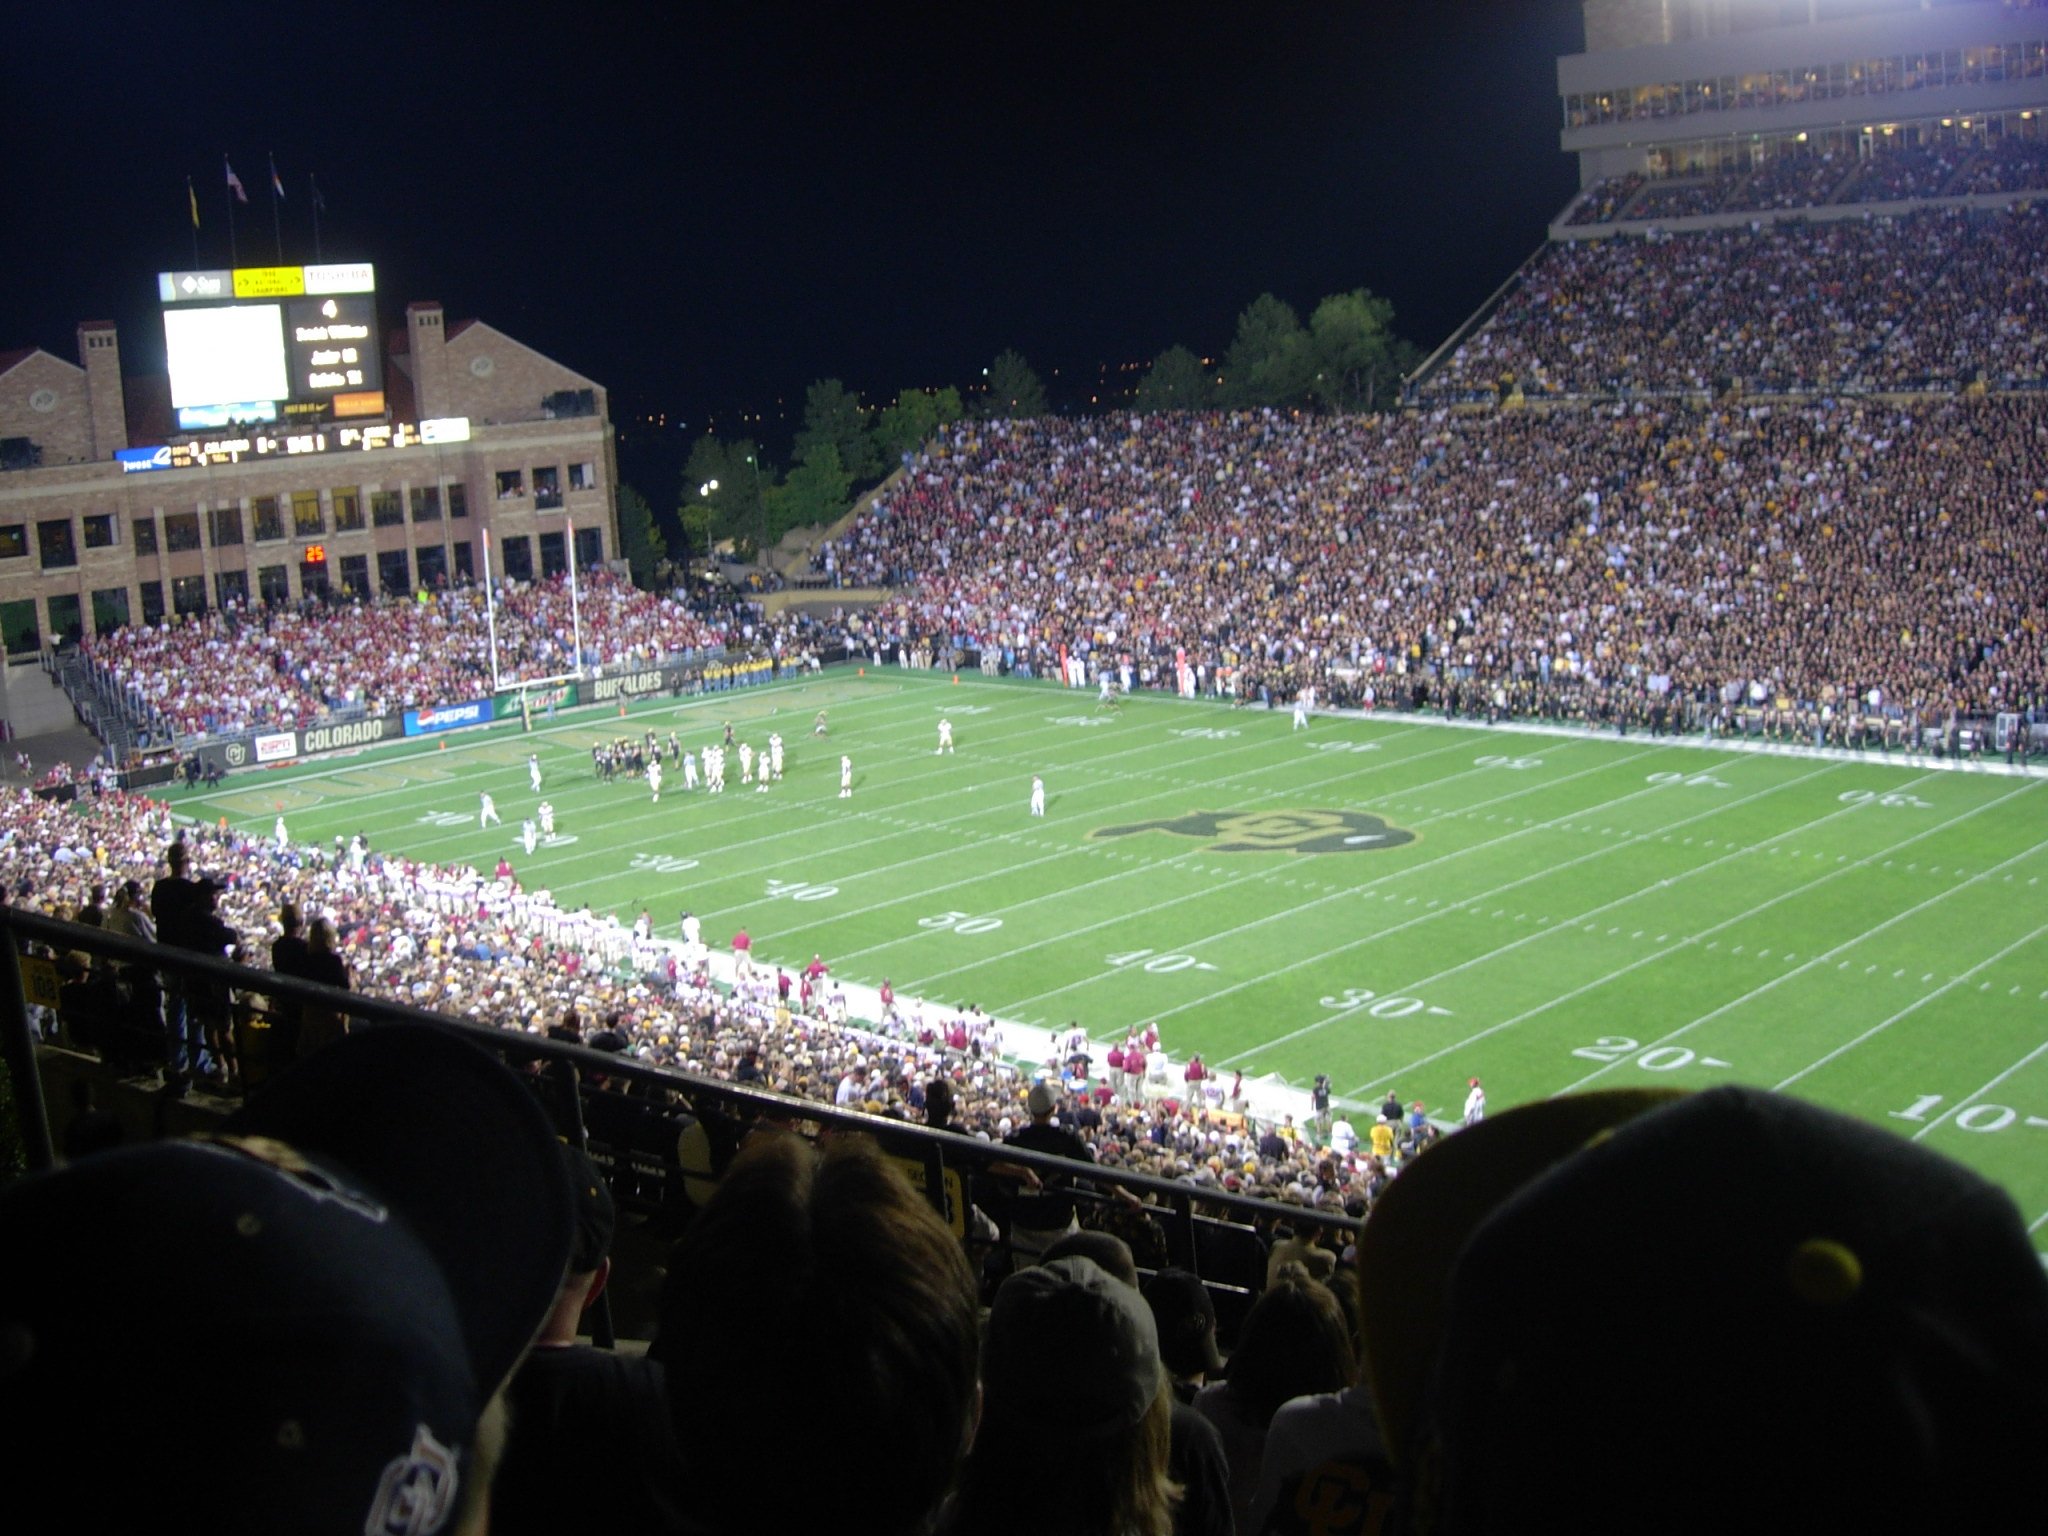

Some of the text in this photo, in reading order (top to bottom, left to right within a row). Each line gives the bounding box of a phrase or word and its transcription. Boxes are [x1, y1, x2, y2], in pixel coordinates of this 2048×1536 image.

[306, 545, 324, 562] 25
[594, 671, 663, 700] BUFFALOES
[433, 704, 481, 725] PEPSI
[304, 719, 382, 752] COLORADO
[918, 911, 1003, 935] 50
[1105, 948, 1197, 974] 40
[1318, 987, 1424, 1018] 30
[1571, 1035, 1695, 1072] 20
[1887, 1094, 2016, 1133] 10
